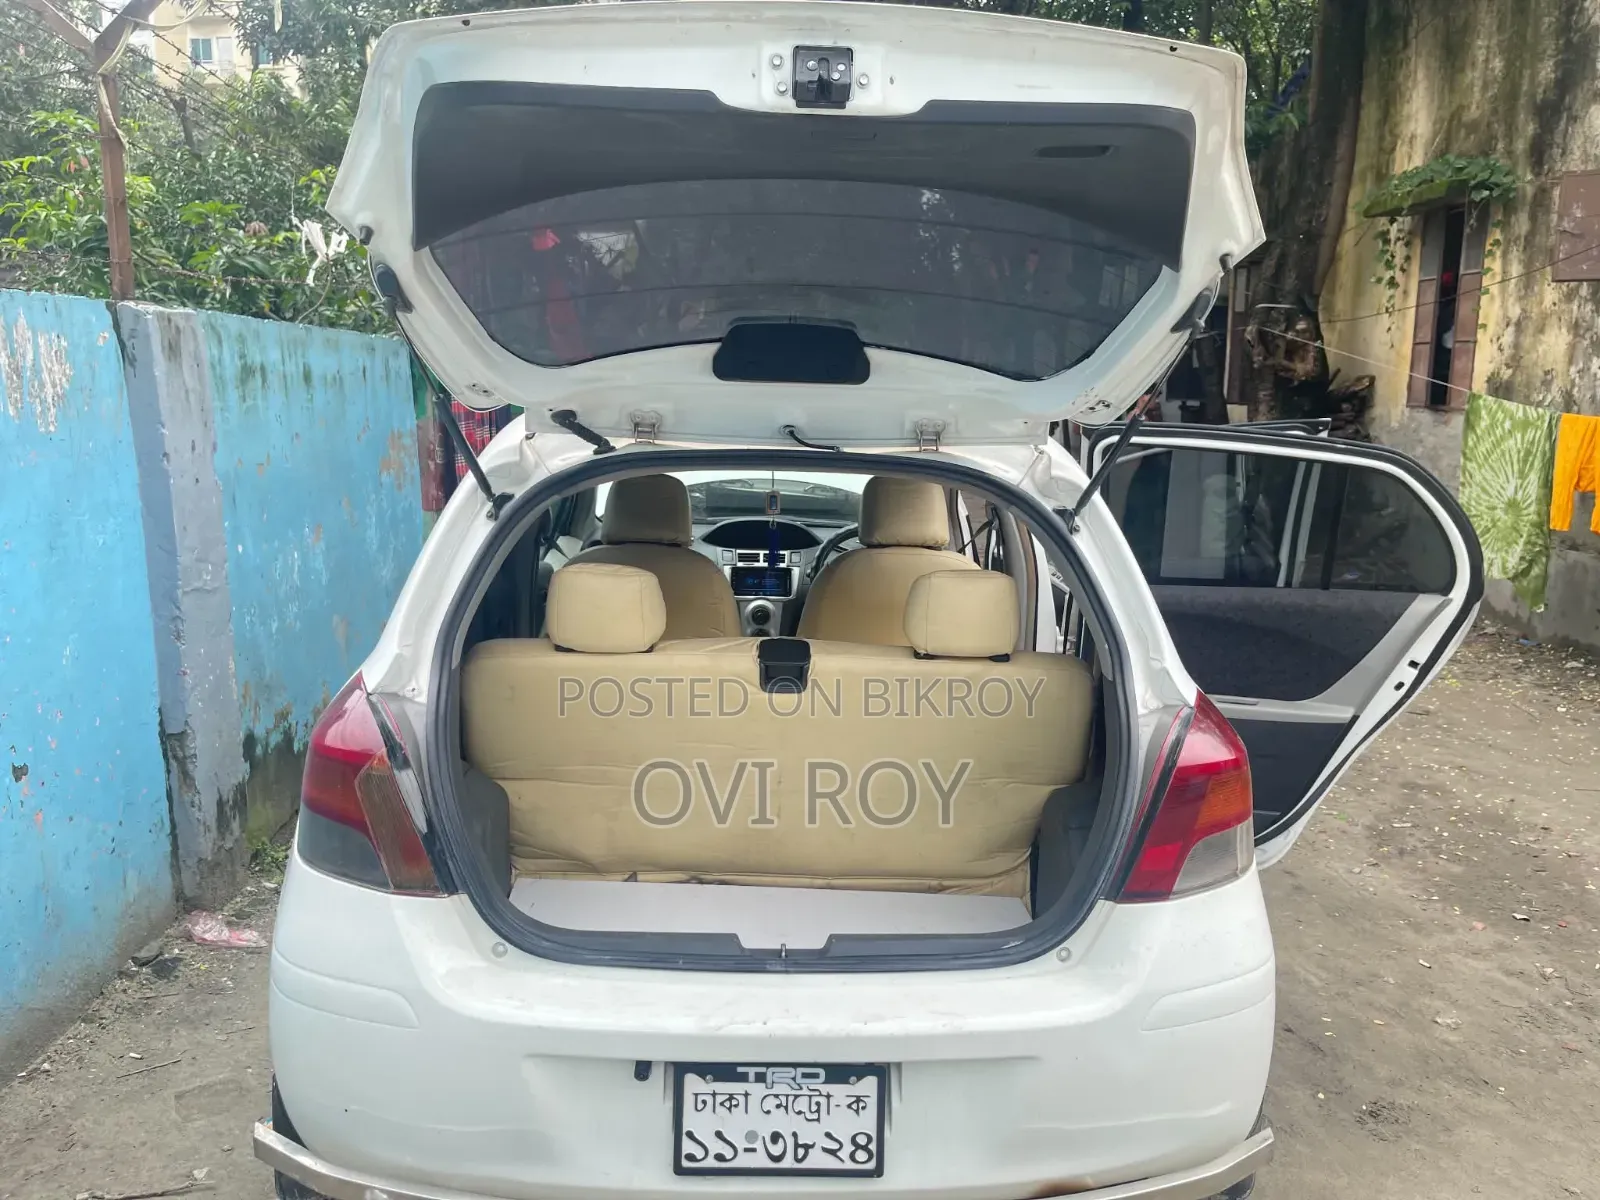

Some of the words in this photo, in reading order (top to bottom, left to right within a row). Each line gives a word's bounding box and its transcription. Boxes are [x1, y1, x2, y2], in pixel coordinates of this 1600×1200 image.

[736, 1066, 826, 1091] TRD
[692, 1090, 752, 1115] ঢাকা
[683, 1129, 875, 1165] ১১-৩৮২৪
